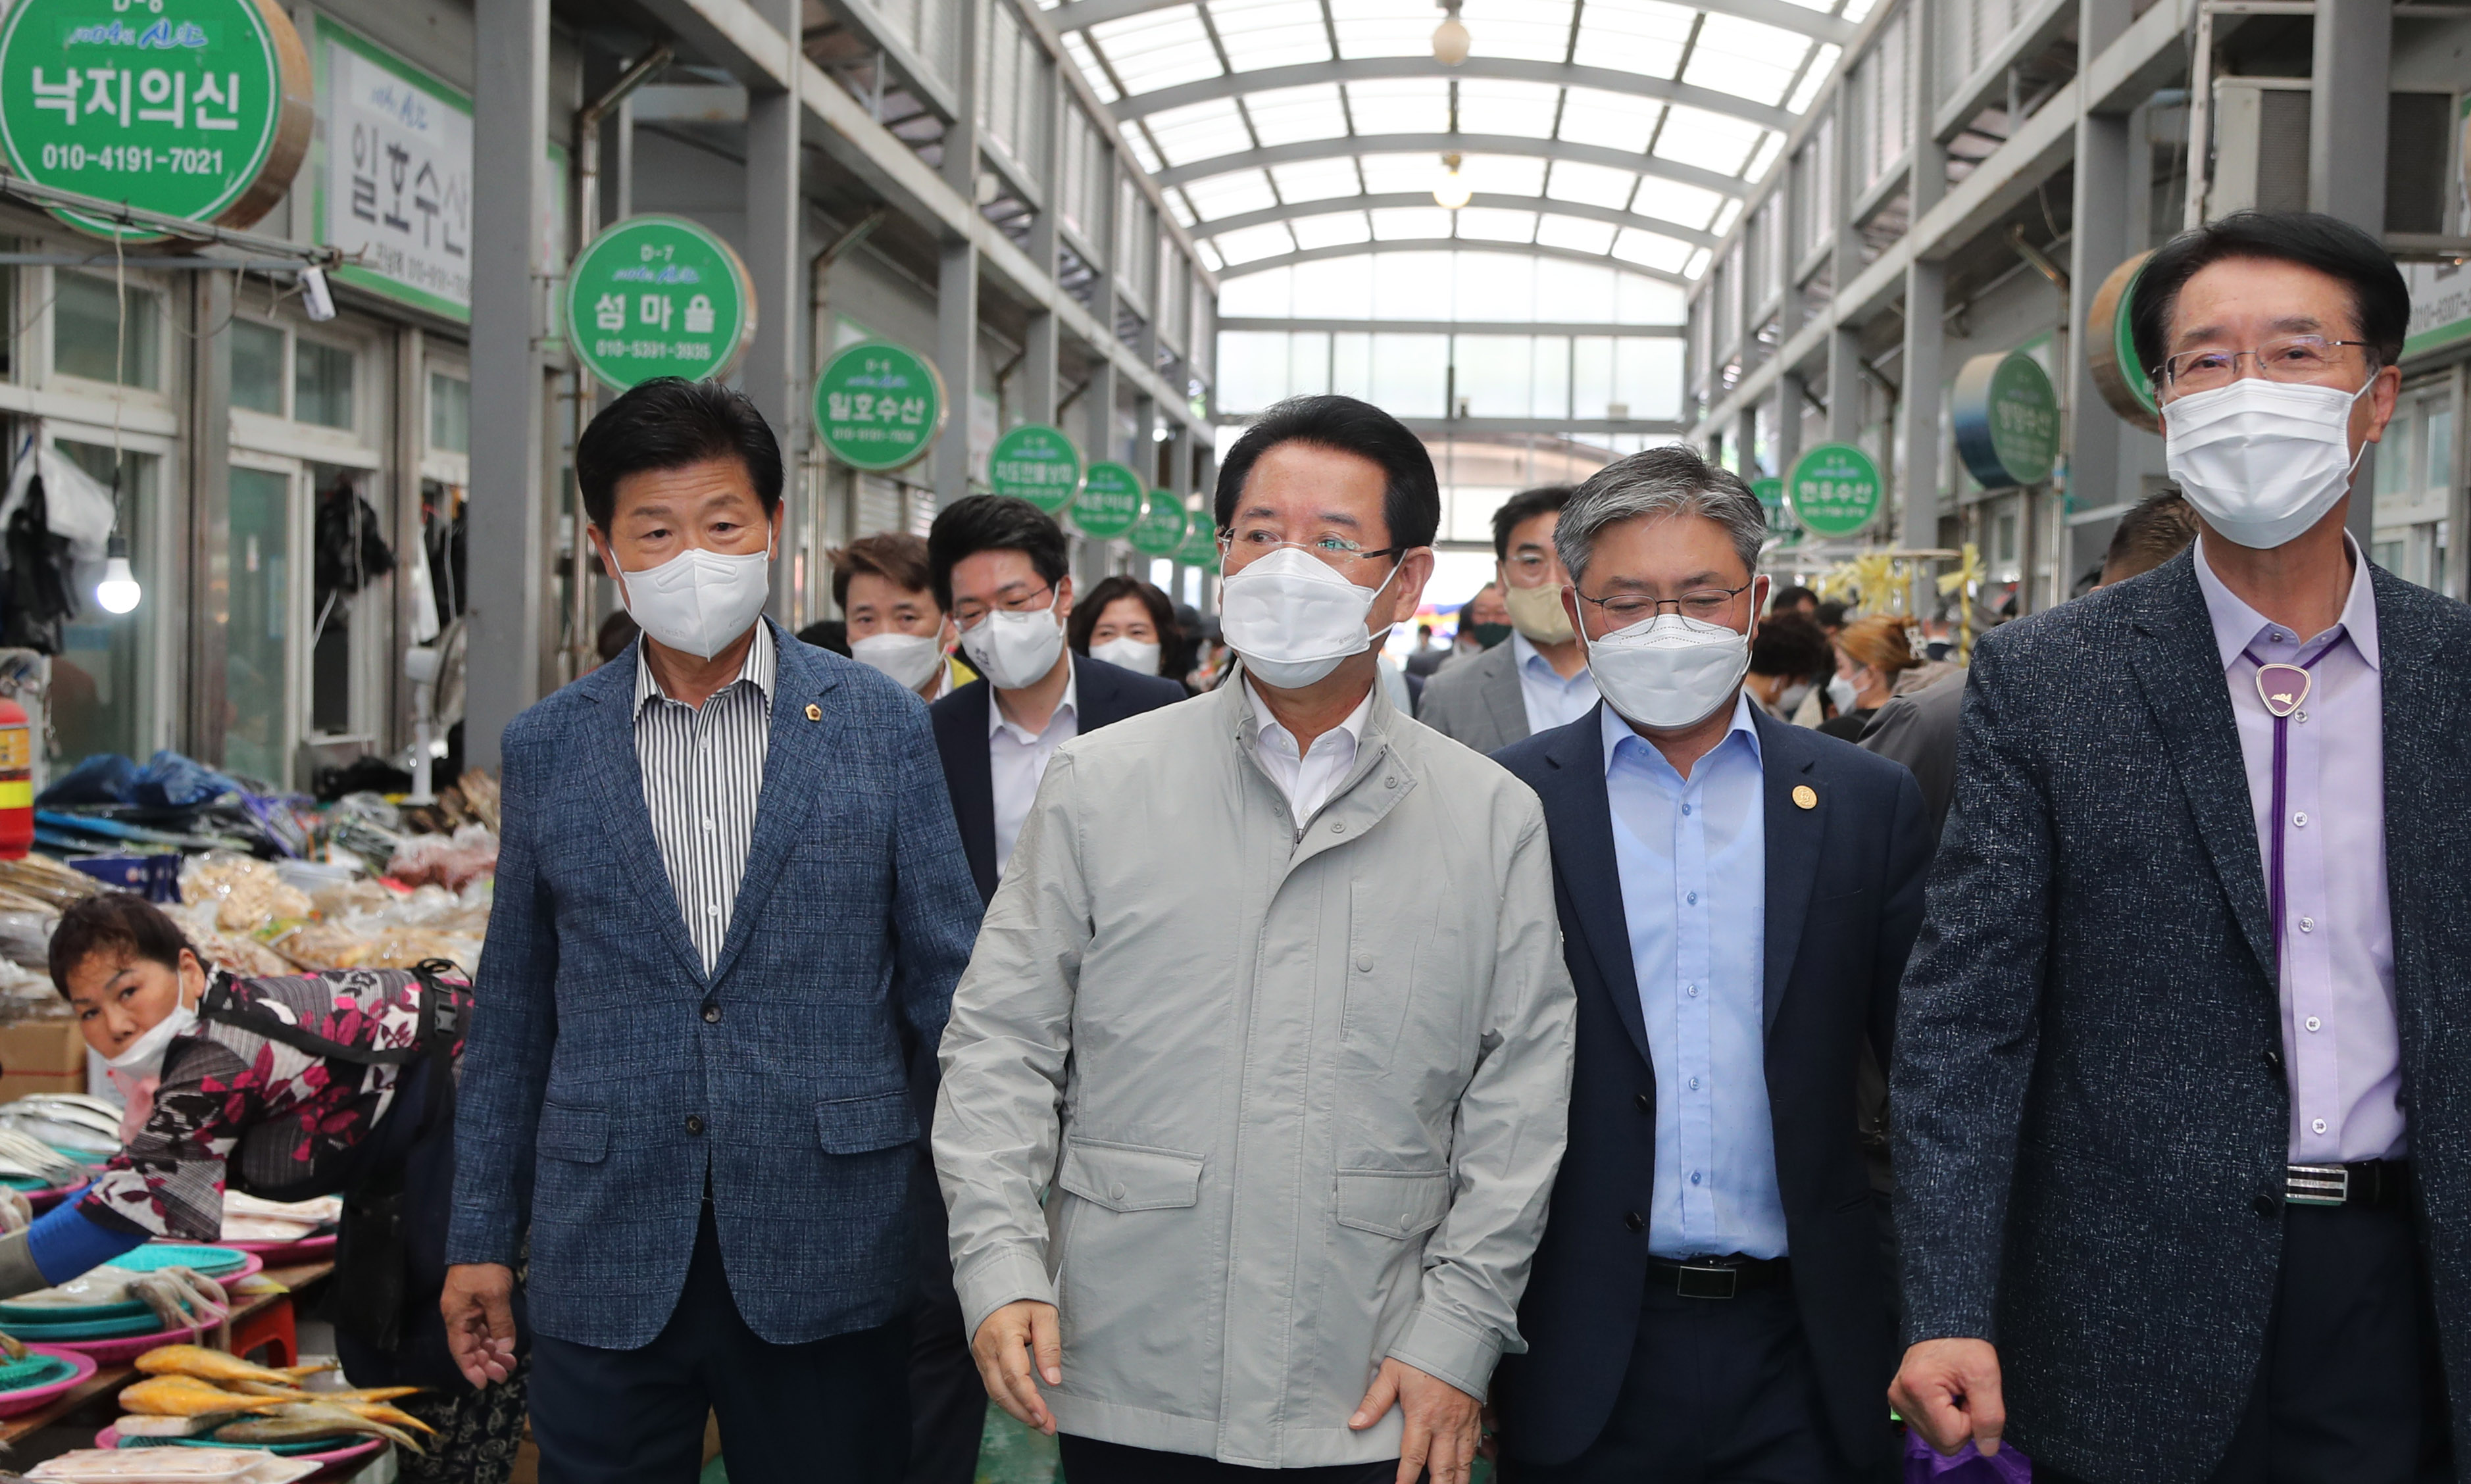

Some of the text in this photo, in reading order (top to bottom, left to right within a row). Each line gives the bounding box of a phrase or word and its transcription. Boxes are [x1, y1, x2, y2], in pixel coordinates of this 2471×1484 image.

[33, 66, 239, 131] 낙지의신
[42, 142, 224, 175] 010-4191-7021
[352, 122, 469, 258] 일호수산
[640, 243, 675, 262] D-7
[828, 391, 926, 425] 일호수산
